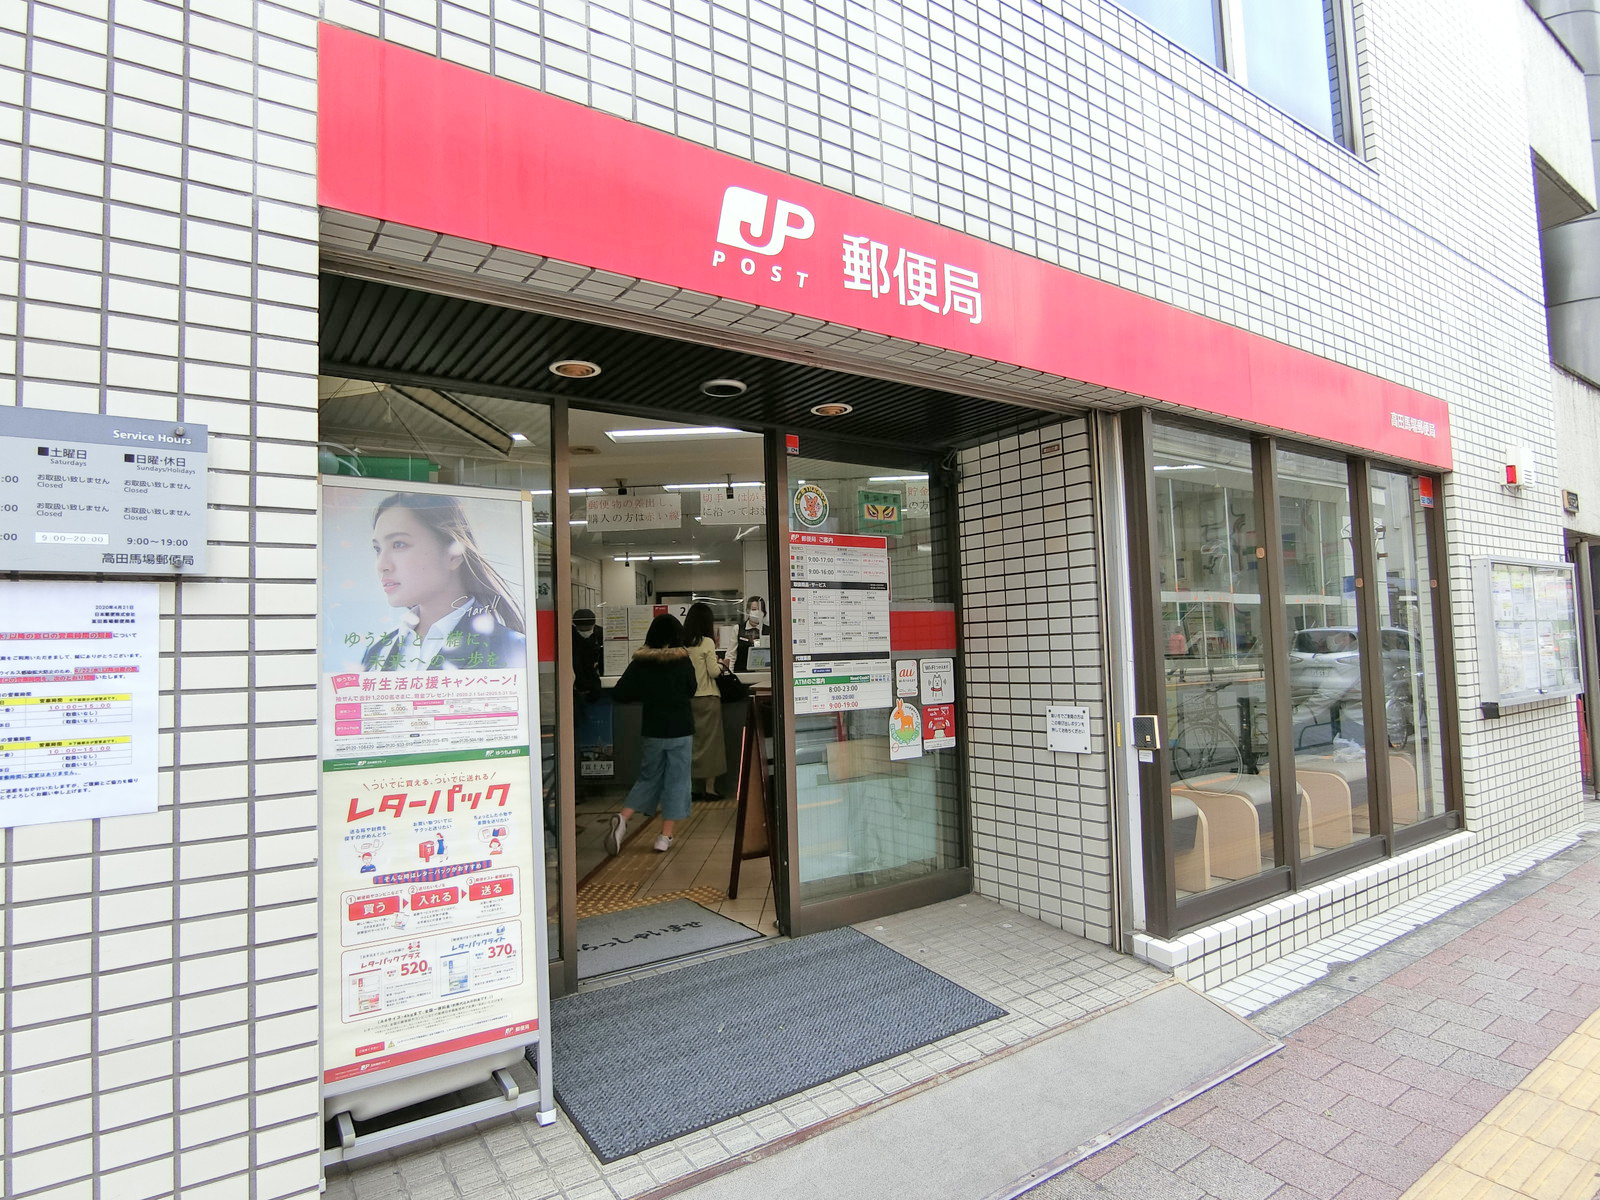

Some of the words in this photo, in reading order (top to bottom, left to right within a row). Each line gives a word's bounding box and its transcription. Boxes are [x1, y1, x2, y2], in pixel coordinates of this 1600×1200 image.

[716, 185, 815, 256] JP
[712, 250, 809, 289] POST
[842, 233, 983, 325] 郵便局
[113, 430, 155, 442] Service
[158, 434, 192, 446] Hours
[50, 449, 87, 460] 土曜日
[50, 458, 87, 467] Saturdays
[136, 465, 196, 475] Sundays/Holidays
[37, 474, 110, 486] お取扱い致しません
[124, 480, 192, 491] お取扱い致しません
[36, 502, 110, 513] お取扱い致しません
[124, 507, 191, 517] お取扱い致しません
[908, 500, 929, 512] の方
[36, 510, 63, 518] Closed
[680, 607, 687, 617] 2
[344, 630, 490, 649] ゆうちょと一緒に、
[367, 651, 509, 670] 未来への一歩を。
[899, 668, 915, 678] au
[794, 677, 826, 686] ATMのご案内
[828, 685, 859, 693] 8:00-23:00
[828, 701, 859, 709] 9:00-19:00
[371, 774, 490, 791] ついでに買える、ついでに送れる
[346, 783, 512, 823] レターパック
[481, 883, 503, 896] 送る
[418, 891, 453, 907] 入れる
[363, 902, 387, 916] 買う
[577, 920, 703, 955] らっしゃいませ
[451, 936, 506, 952] レターパックライト
[361, 952, 421, 969] レターパックプラス
